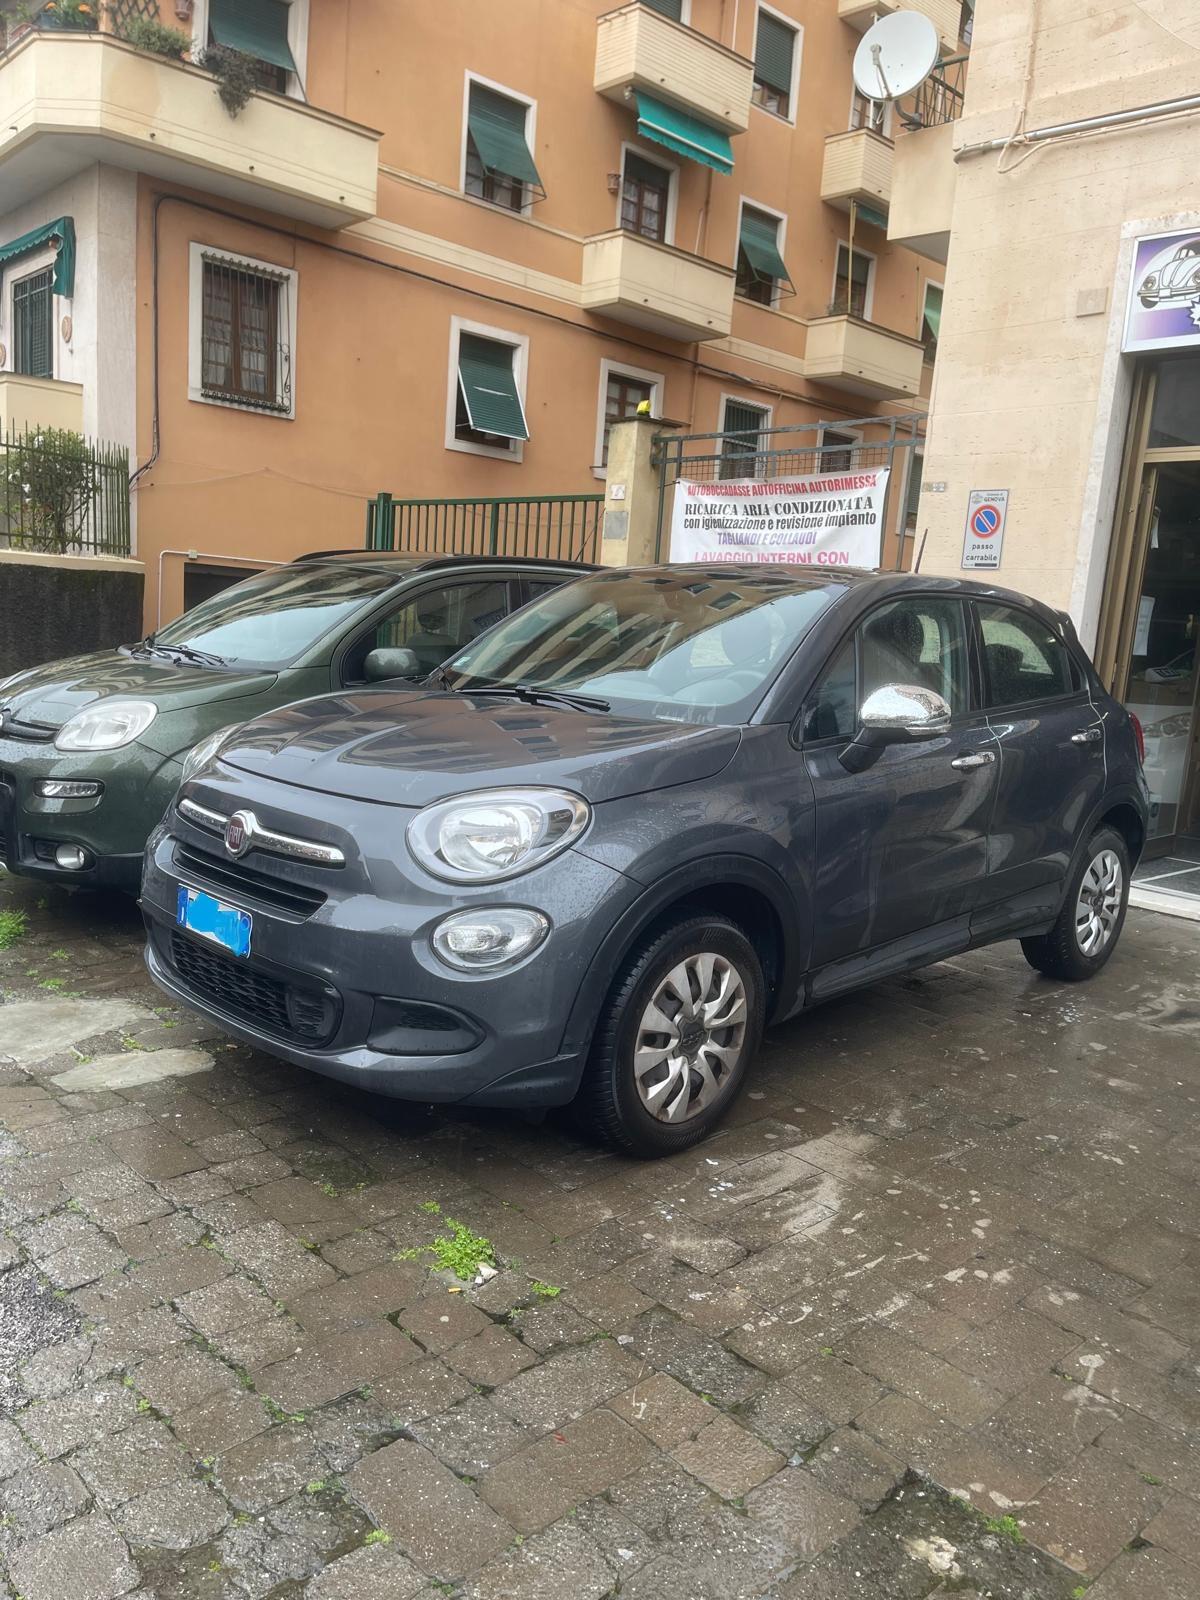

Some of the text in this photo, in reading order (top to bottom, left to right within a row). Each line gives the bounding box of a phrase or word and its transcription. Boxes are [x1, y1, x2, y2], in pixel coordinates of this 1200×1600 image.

[687, 475, 877, 496] AUTOBOCCADASSE AUTOFFICINA AUTORIMESSA
[685, 496, 873, 516] RICARICA ARIA CONDIZIONATA
[684, 512, 877, 530] con igienizzazione e revisione impianto
[717, 531, 818, 545] TAGLIANDI E COLLAUDI
[757, 552, 812, 564] INTERNI
[817, 551, 850, 564] CON
[229, 825, 243, 845] FIAT
